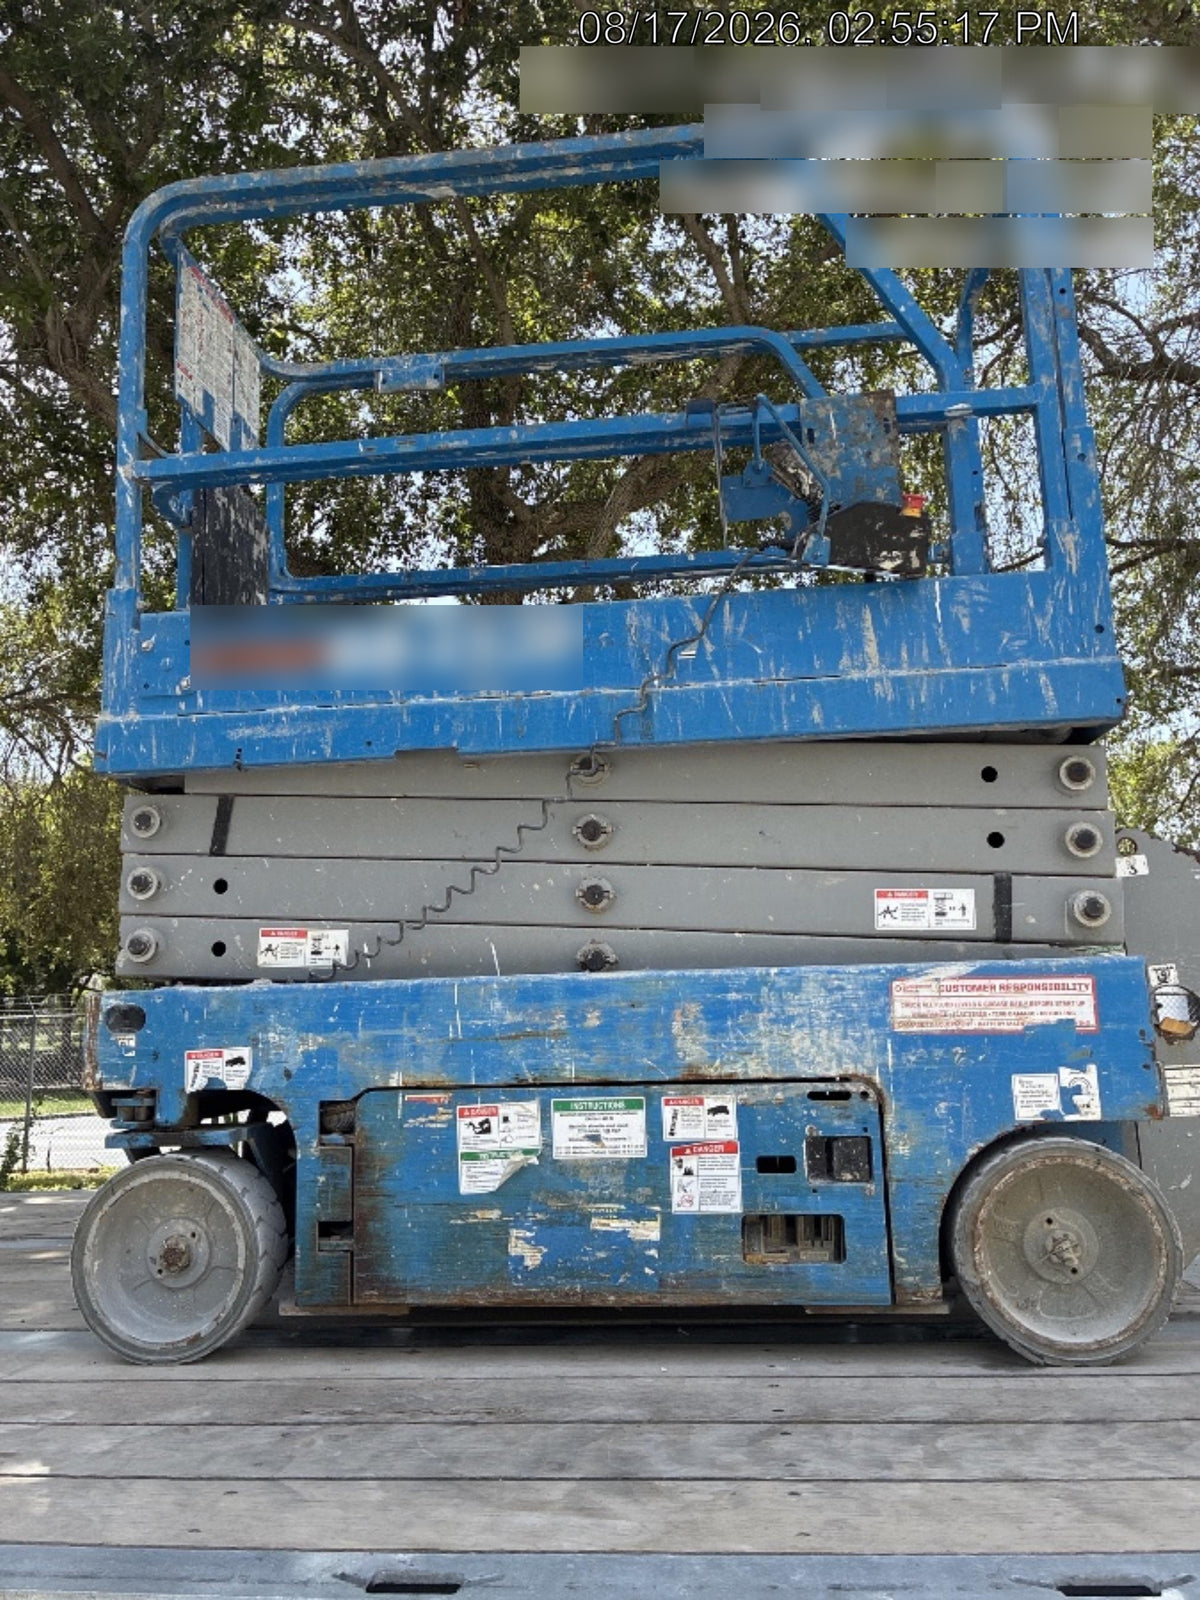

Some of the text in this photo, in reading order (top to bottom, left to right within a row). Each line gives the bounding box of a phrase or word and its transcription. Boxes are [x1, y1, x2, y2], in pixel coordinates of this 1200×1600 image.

[938, 984, 996, 993] CUSTOMER
[998, 982, 1090, 992] RESPONSIBILITY
[570, 1101, 626, 1110] INSTRUCTIONS
[692, 1144, 725, 1154] DANGER
